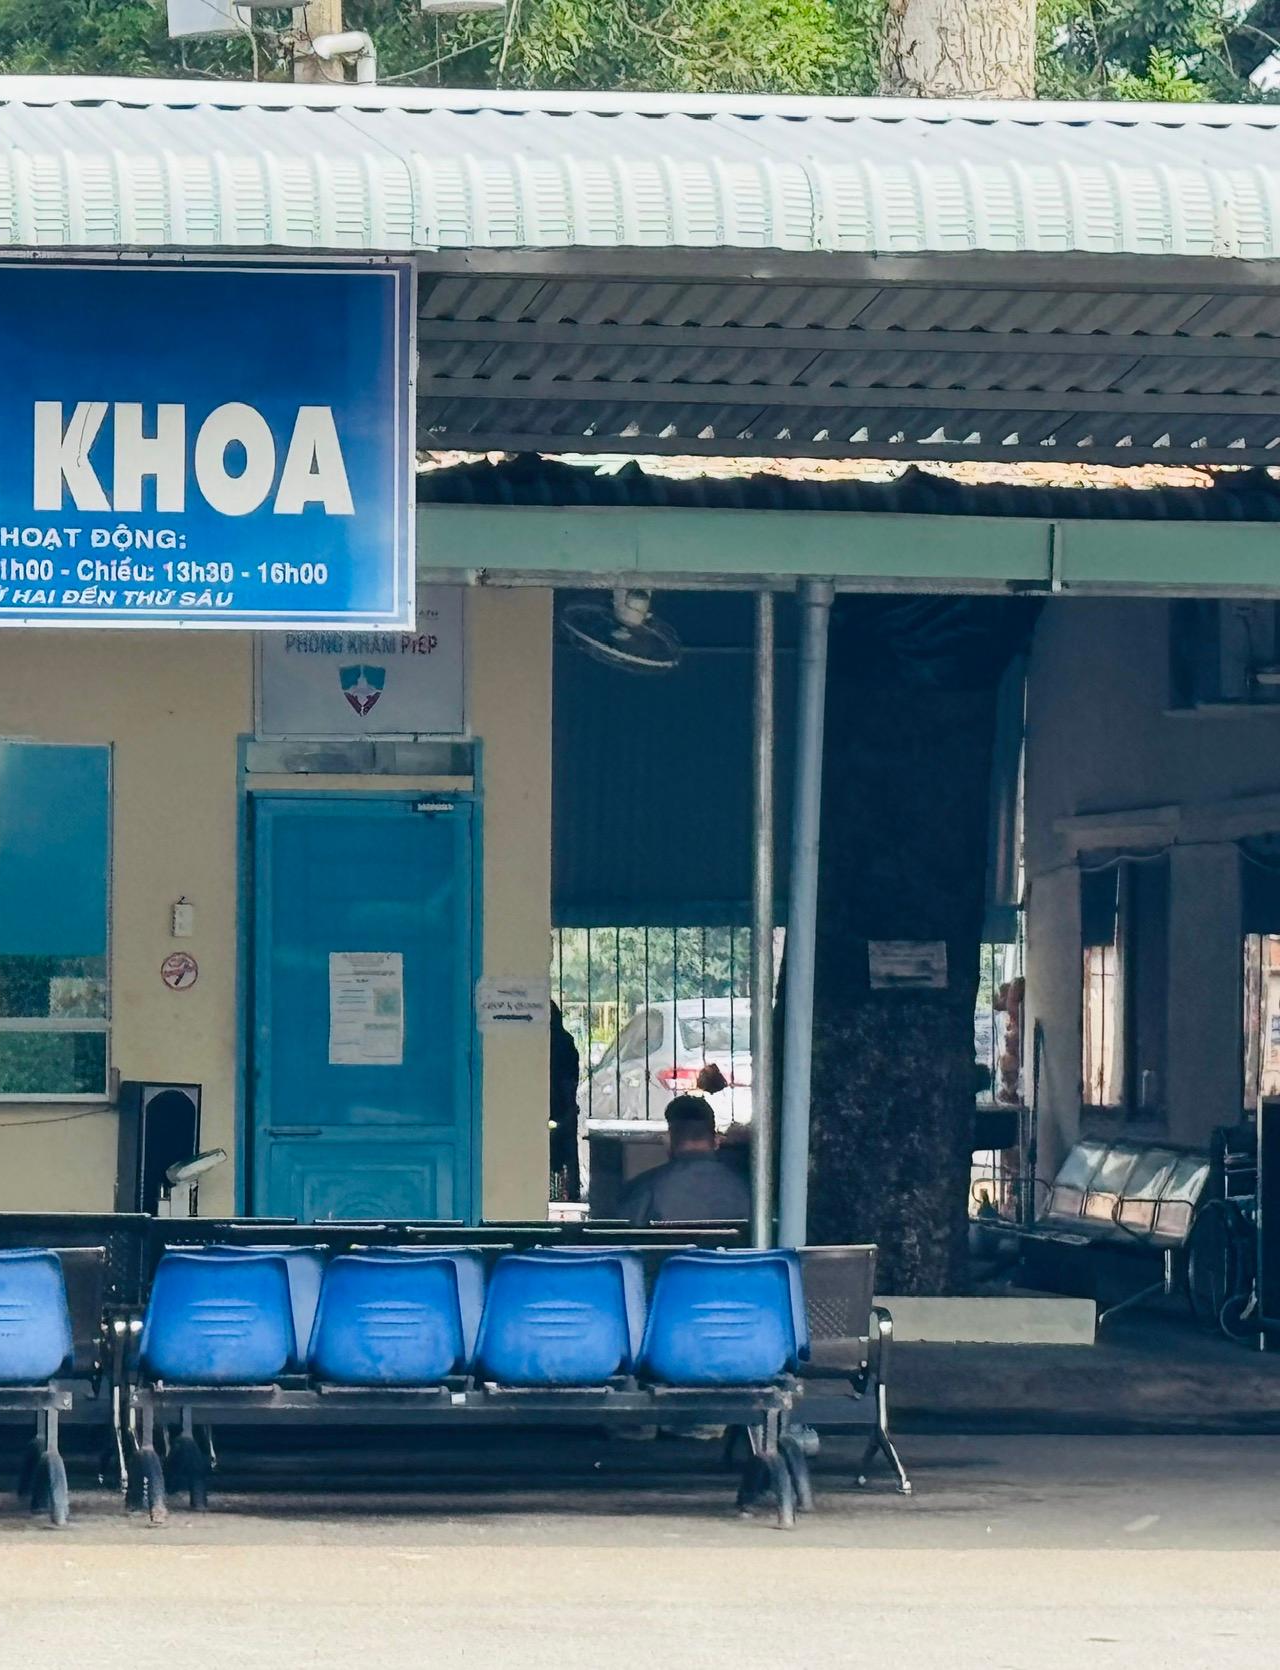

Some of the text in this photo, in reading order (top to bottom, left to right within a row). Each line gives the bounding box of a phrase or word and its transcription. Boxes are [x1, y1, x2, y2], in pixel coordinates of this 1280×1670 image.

[33, 400, 356, 517] KHOA
[0, 527, 82, 551] HOẠT
[90, 523, 187, 552] ĐỘNG:
[162, 561, 234, 584] 13h30
[257, 562, 328, 585] 16h00
[11, 589, 56, 604] HAI
